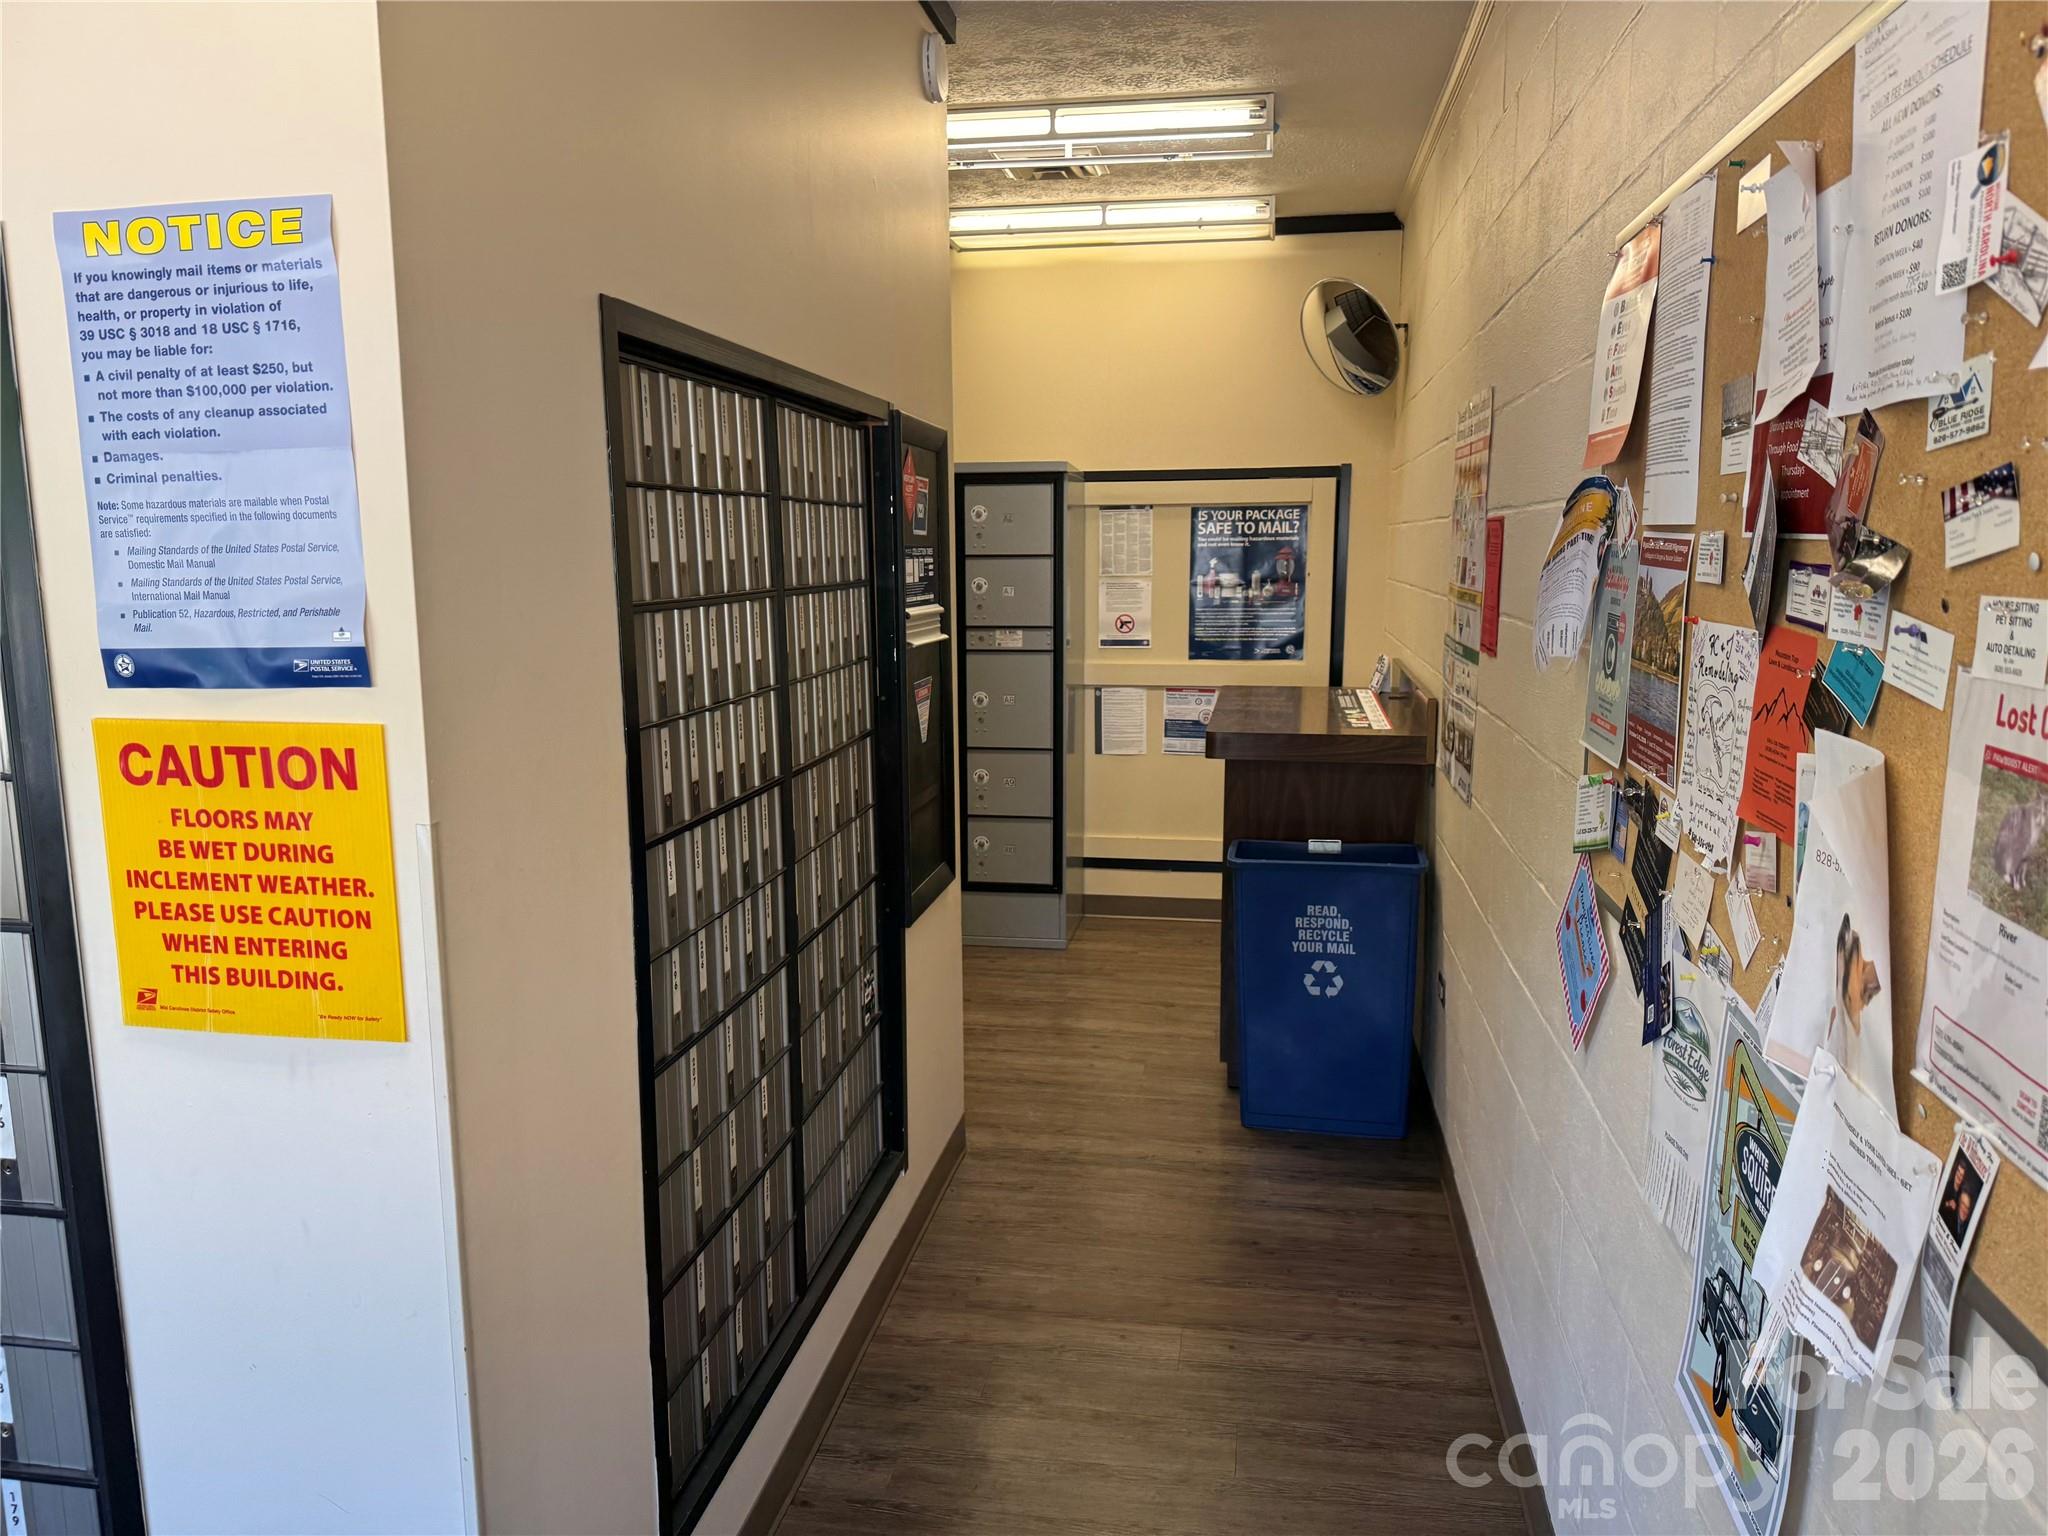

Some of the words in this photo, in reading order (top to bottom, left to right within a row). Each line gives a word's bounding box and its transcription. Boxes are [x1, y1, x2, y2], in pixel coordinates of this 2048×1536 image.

[1931, 34, 1973, 73] SCHEDULE
[1982, 186, 1995, 222] NORTH
[82, 207, 304, 258] NOTICE
[1895, 209, 1932, 237] DONORS:
[1978, 225, 1992, 277] CAROLINA
[73, 272, 82, 284] If
[85, 273, 108, 286] you
[111, 266, 172, 282] knowingly
[176, 264, 203, 278] mail
[207, 264, 242, 276] items
[244, 263, 258, 273] or
[261, 257, 322, 272] materials
[75, 291, 101, 303] that
[104, 292, 124, 302] are
[127, 287, 192, 302] dangerous
[195, 286, 210, 296] or
[213, 282, 268, 297] injurious
[271, 280, 285, 292] to
[288, 278, 313, 292] life,
[77, 309, 120, 322] health,
[123, 310, 137, 320] or
[140, 305, 191, 322] property
[194, 304, 208, 316] in
[211, 301, 265, 315] violation
[269, 300, 282, 312] of
[79, 329, 95, 342] 39
[98, 328, 125, 340] USC
[129, 327, 137, 342] §
[140, 325, 171, 338] 3018
[174, 323, 197, 336] and
[201, 323, 218, 335] 18
[222, 321, 249, 334] USC
[253, 320, 261, 335] §
[265, 319, 300, 332] 1716,
[81, 351, 103, 363] you
[106, 349, 132, 361] may
[135, 346, 151, 358] be
[154, 344, 187, 357] liable
[190, 343, 213, 355] for:
[96, 370, 105, 382] A
[108, 369, 133, 382] civil
[136, 367, 181, 382] penalty
[184, 366, 197, 378] of
[200, 366, 214, 377] at
[217, 364, 250, 376] least
[252, 362, 288, 376] $250,
[292, 361, 314, 373] but
[98, 389, 118, 400] not
[121, 390, 152, 400] more
[154, 386, 183, 398] than
[186, 383, 247, 398] $100,000
[250, 385, 272, 397] per
[275, 380, 333, 394] violation.
[99, 411, 123, 422] The
[126, 410, 160, 422] costs
[162, 408, 175, 420] of
[178, 410, 200, 422] any
[204, 406, 254, 419] cleanup
[258, 402, 327, 416] associated
[1938, 414, 1958, 427] BLUE
[1961, 405, 1985, 420] RIDGE
[102, 429, 128, 441] with
[131, 428, 161, 440] each
[164, 426, 221, 439] violation.
[103, 451, 164, 464] Damages.
[1768, 443, 1786, 457] Through
[1787, 440, 1799, 454] Food
[106, 472, 158, 484] Criminal
[161, 470, 222, 485] penalties.
[1782, 465, 1806, 477] Thursdays
[97, 500, 120, 513] Note:
[120, 500, 144, 512] Some
[145, 499, 187, 510] hazardous
[188, 498, 226, 508] materials
[228, 499, 242, 508] are
[244, 496, 278, 507] mailable
[279, 496, 303, 506] when
[304, 495, 330, 506] Postal
[1198, 510, 1208, 521] IS
[1212, 510, 1243, 520] YOUR
[1246, 509, 1300, 520] PACKAGE
[1198, 522, 1232, 535] SAFE
[1235, 522, 1255, 534] TO
[1258, 520, 1300, 534] MAIL?
[2015, 603, 2039, 614] SITTING
[1995, 614, 2008, 625] PET
[2009, 616, 2032, 628] SITTING
[2009, 630, 2014, 640] &
[1986, 642, 2002, 653] AUTO
[2003, 645, 2036, 659] DETAILING
[1698, 655, 1739, 692] Remodeling
[1996, 694, 2037, 736] Lost
[118, 742, 359, 791] CAUTION
[170, 808, 259, 830] FLOORS
[264, 810, 313, 831] MAY
[158, 839, 186, 859] BE
[189, 840, 238, 861] WET
[243, 842, 334, 864] DURING
[1815, 850, 1840, 872] 828-5
[126, 869, 253, 893] INCLEMENT
[256, 874, 374, 898] WEATHER.
[134, 900, 216, 923] PLEASE
[220, 904, 264, 925] USE
[268, 906, 372, 930] CAUTION
[1307, 905, 1341, 917] READ,
[1295, 917, 1352, 931] RESPOND,
[1999, 923, 2018, 944] River
[162, 932, 229, 955] WHEN
[234, 936, 348, 960] ENTERING
[1298, 930, 1349, 942] RECYCLE
[1292, 941, 1323, 953] YOUR
[1327, 943, 1356, 955] MAIL
[171, 964, 221, 986] THIS
[226, 967, 344, 992] BUILDING.
[1663, 1033, 1689, 1062] Forest
[1687, 1046, 1710, 1082] Edge
[1749, 1136, 1769, 1170] WHITE
[1900, 1179, 1912, 1192] GET
[1755, 1194, 1769, 1220] WEEK
[9, 1491, 19, 1526] 179
